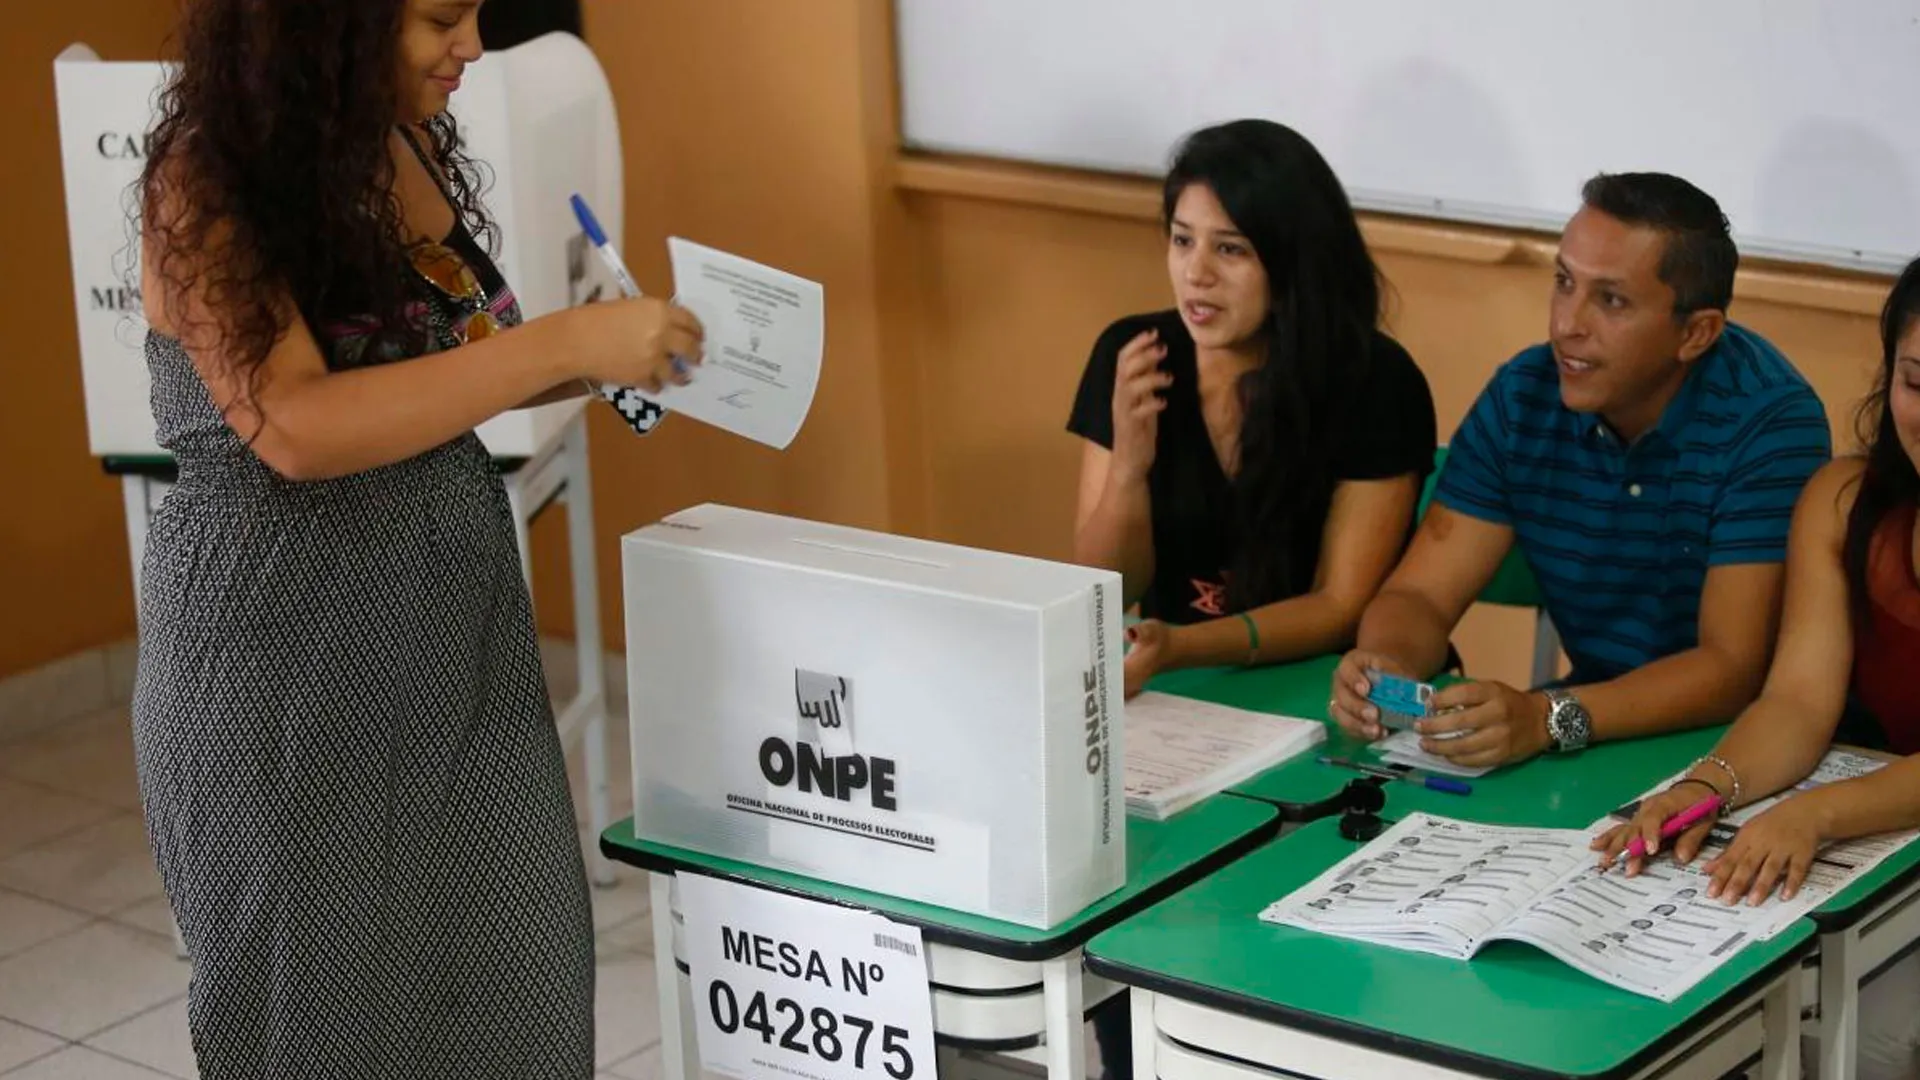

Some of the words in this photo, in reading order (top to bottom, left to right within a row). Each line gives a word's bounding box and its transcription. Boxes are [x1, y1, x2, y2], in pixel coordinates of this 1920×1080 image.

[1095, 584, 1105, 660] ELECTORALES
[1084, 665, 1101, 774] ONPE
[759, 737, 897, 812] ONPE
[726, 793, 762, 809] OFICINA
[764, 802, 810, 819] NACIONAL
[812, 812, 825, 822] DE
[827, 815, 873, 832] PROCESOS
[875, 825, 935, 846] ELECTORALES
[722, 925, 832, 987] MESA
[709, 979, 914, 1080] 042875
